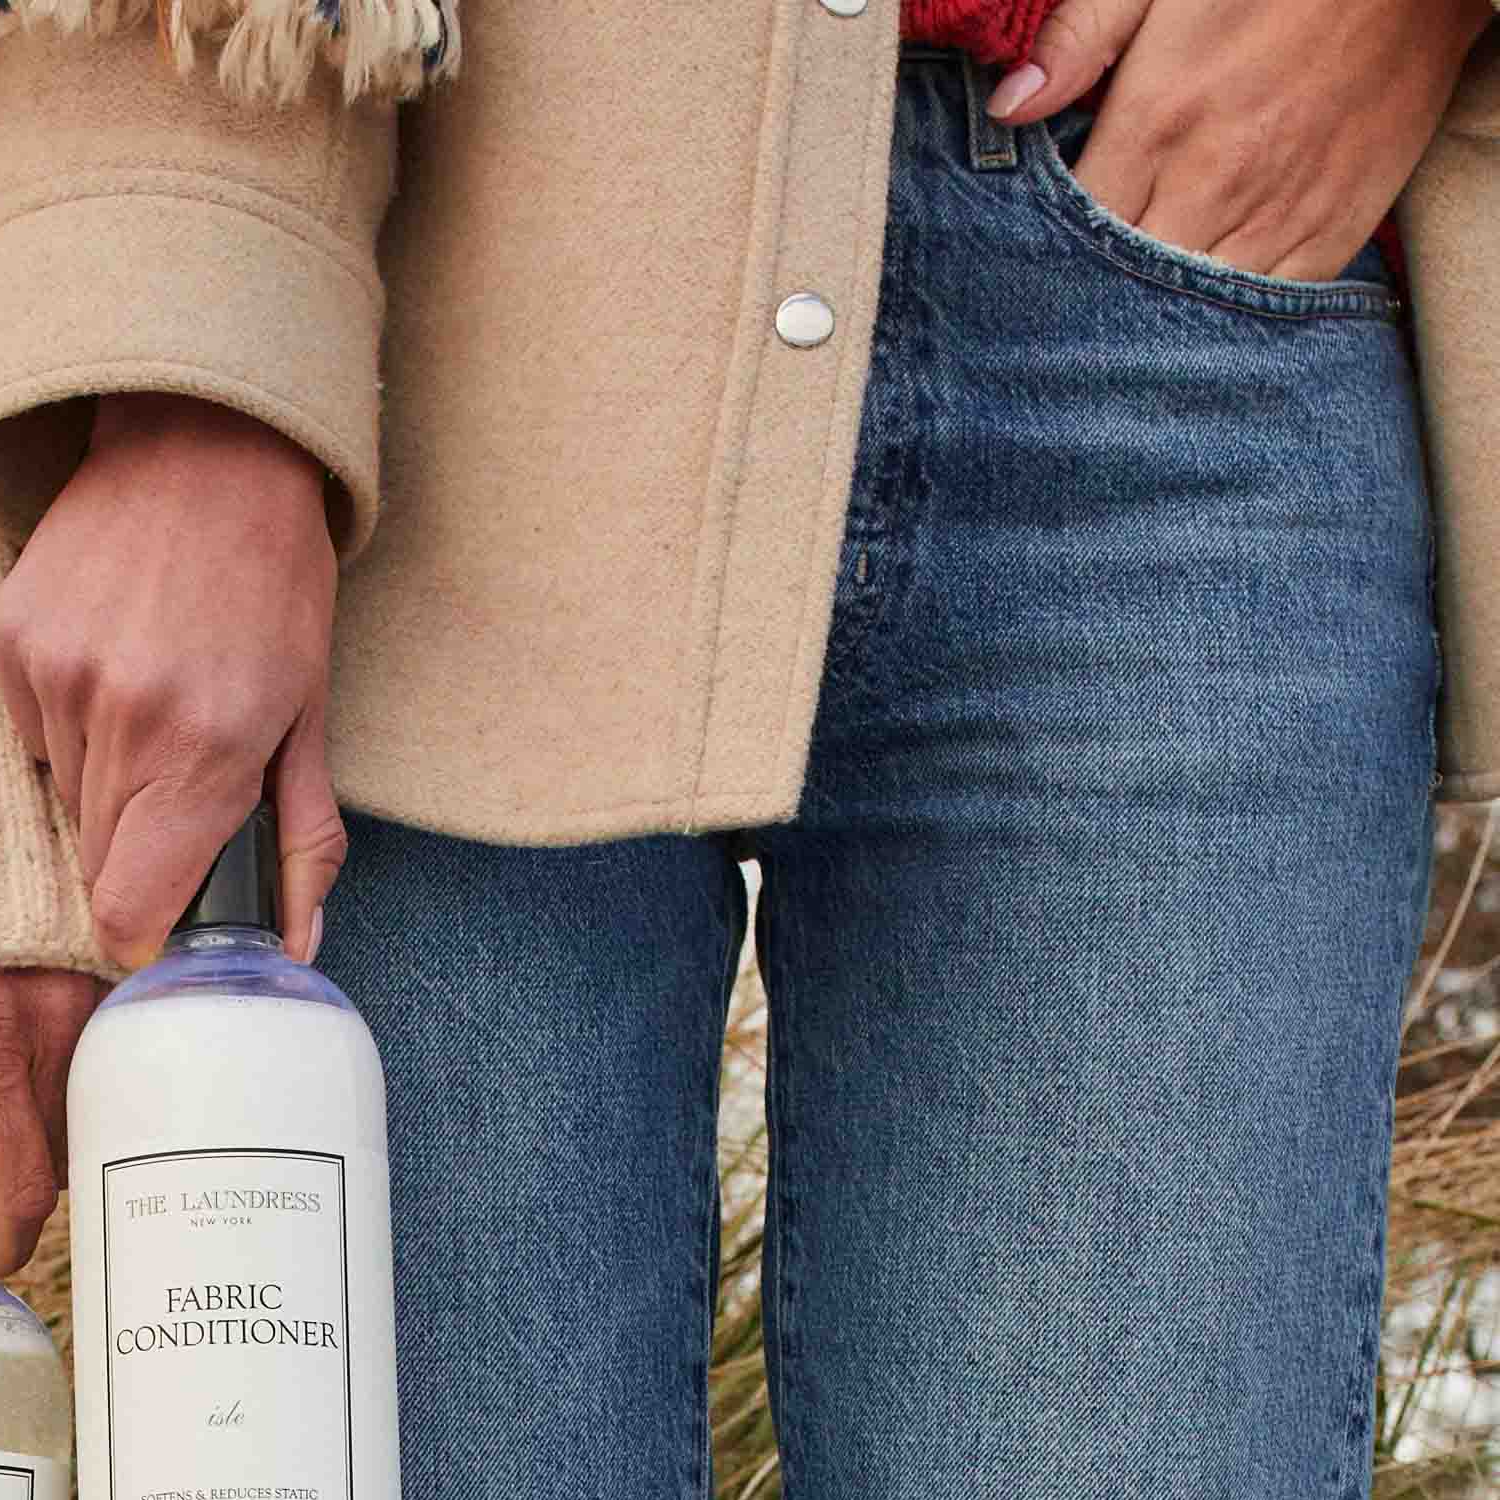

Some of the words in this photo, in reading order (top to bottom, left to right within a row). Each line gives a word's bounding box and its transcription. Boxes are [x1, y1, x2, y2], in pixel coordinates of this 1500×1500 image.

[125, 1195, 167, 1219] THE
[180, 1189, 321, 1213] LAUNDRESS
[190, 1217, 216, 1228] NEW
[223, 1216, 253, 1225] YORK
[166, 1284, 283, 1313] FABRIC
[116, 1319, 339, 1355] CONDITIONER
[207, 1399, 245, 1427] isle
[195, 1490, 206, 1500] &
[211, 1488, 271, 1500] REDUCES
[274, 1488, 318, 1500] STATIC
